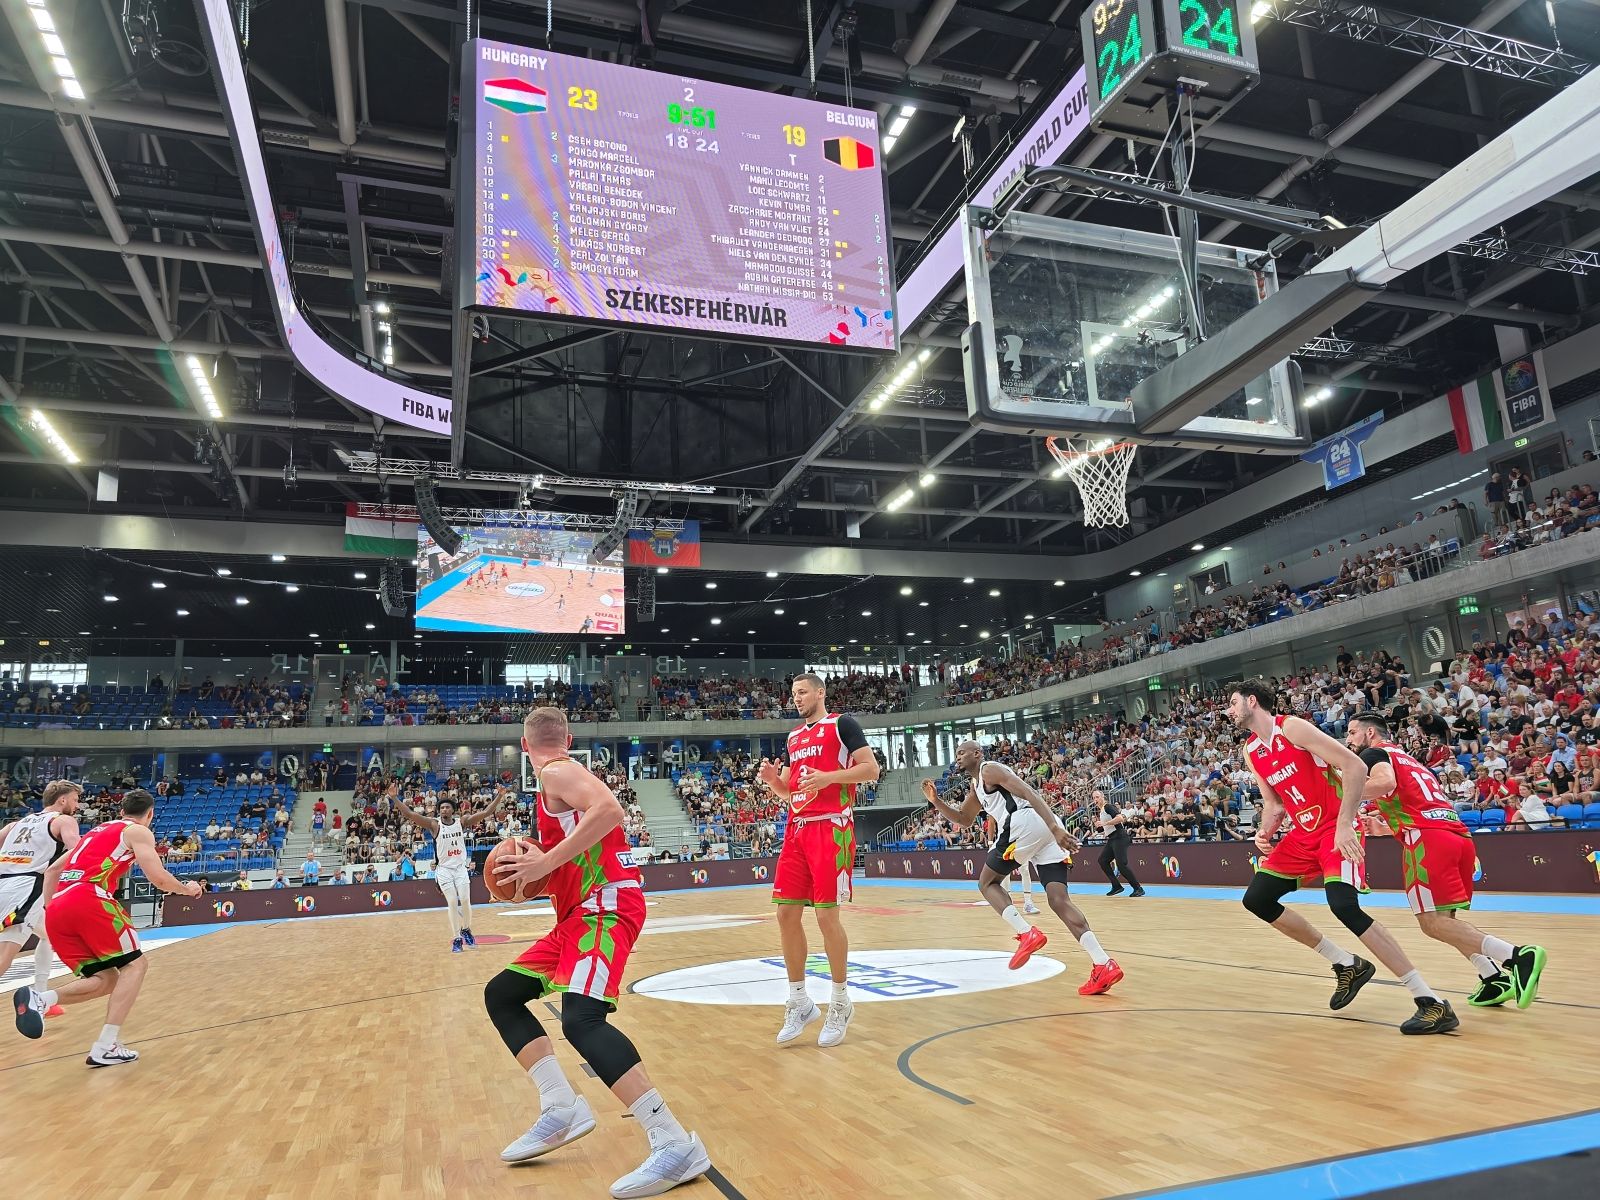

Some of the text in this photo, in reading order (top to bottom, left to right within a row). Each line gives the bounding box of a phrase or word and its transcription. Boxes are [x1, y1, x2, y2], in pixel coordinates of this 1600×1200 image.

[1179, 0, 1238, 56] 24
[481, 47, 548, 71] HUNGARY
[1098, 13, 1142, 99] 24
[1171, 44, 1255, 69] www.visualsolutions.hu
[567, 86, 598, 112] 23
[683, 87, 695, 102] 2
[667, 103, 716, 130] 9:51
[826, 110, 876, 130] BELGIUM
[487, 121, 493, 130] 1
[486, 132, 493, 141] 3
[782, 124, 806, 147] 19
[665, 133, 720, 154] 18 24
[487, 154, 493, 165] 5
[569, 156, 612, 172] MARONKA
[600, 150, 639, 165] MARCELL
[483, 166, 494, 176] 10
[739, 162, 774, 176] YANNICK
[483, 178, 494, 188] 12
[774, 178, 810, 192] LECOMTE
[818, 174, 825, 184] 2
[483, 190, 494, 200] 13
[604, 185, 643, 199] BENEDEK
[767, 188, 811, 203] SCHWARTZ
[819, 185, 825, 195] 4
[483, 201, 494, 212] 14
[759, 198, 811, 213] KEVIN TUMBA
[817, 195, 826, 205] 11
[620, 210, 647, 222] BORIS
[640, 202, 677, 216] VINCENT
[728, 204, 773, 218] ZACCHARIE
[816, 205, 828, 216] 16
[483, 213, 494, 224] 16
[817, 216, 829, 227] 22
[483, 225, 494, 235] 18
[570, 226, 599, 238] MELEG
[739, 227, 775, 240] LEANDER
[749, 218, 813, 235] ANDY VAN VLIET
[817, 226, 830, 237] 24
[482, 237, 496, 247] 20
[710, 234, 750, 248] THIBAULT
[818, 237, 830, 247] 27
[482, 248, 496, 260] 30
[570, 249, 594, 261] PERL
[606, 242, 647, 256] NORBERT
[728, 247, 752, 259] NIELS
[753, 250, 770, 261] VAN
[771, 253, 787, 263] DEN
[820, 248, 830, 258] 31
[744, 260, 786, 274] MAMADOU
[819, 258, 832, 269] 34
[745, 271, 817, 289] AUBIN GATERETSE
[820, 269, 833, 280] 44
[738, 282, 771, 295] NATHAN
[821, 280, 834, 291] 45
[822, 291, 834, 302] 53
[605, 286, 788, 328] SZÉKESFEHÉRVÁR
[402, 397, 434, 420] FIBA
[1512, 394, 1537, 414] FIBA
[1330, 439, 1351, 463] 24
[789, 745, 823, 763] HUNGARY
[1266, 761, 1299, 786] HUNGARY
[792, 793, 807, 803] MOL
[1284, 785, 1306, 806] 14
[70, 836, 93, 865] 1
[751, 865, 769, 880] 10
[877, 859, 885, 874] 10
[903, 859, 912, 875] 10
[931, 859, 941, 875] 10
[963, 859, 974, 875] 10
[1161, 856, 1180, 878] 10
[690, 868, 709, 884] 10
[294, 895, 316, 912] 10
[371, 890, 392, 907] 10
[213, 899, 236, 918] 10
